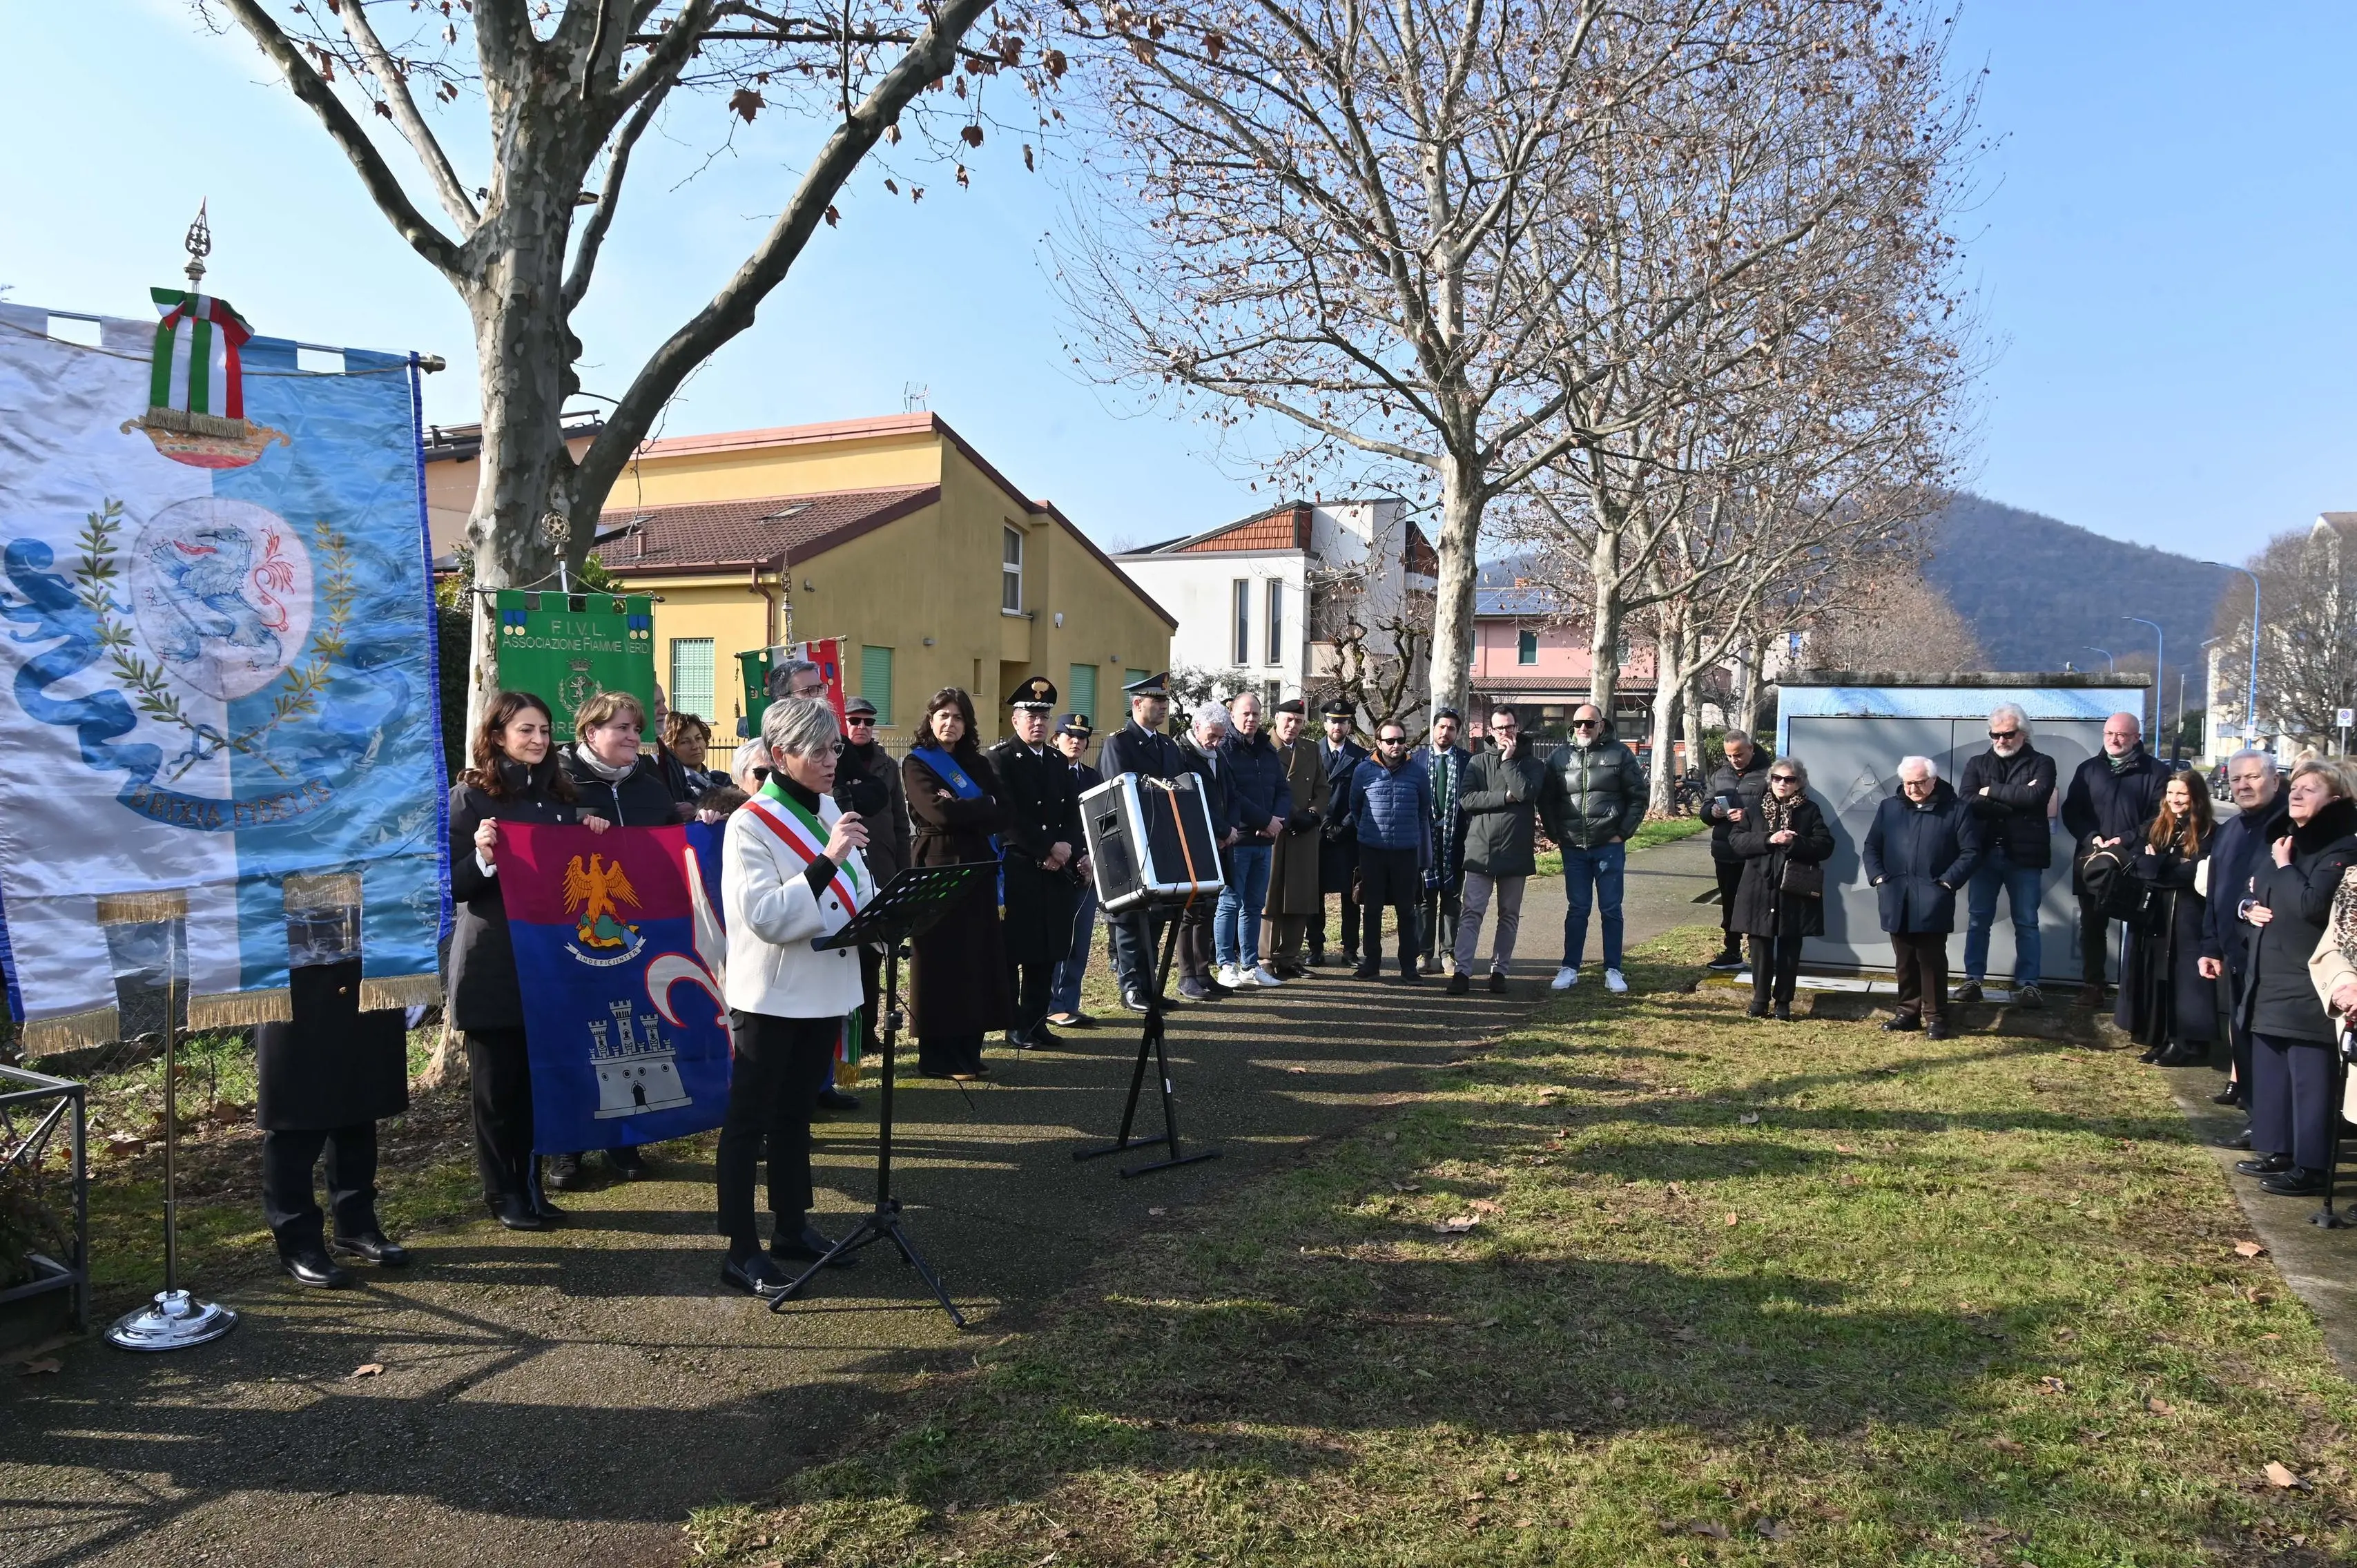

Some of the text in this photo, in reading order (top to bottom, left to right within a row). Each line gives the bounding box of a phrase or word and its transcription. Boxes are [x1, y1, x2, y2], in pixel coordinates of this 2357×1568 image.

[128, 780, 330, 827] BRIXIA FIDELIS
[579, 950, 639, 966] INDEFICIENTER
